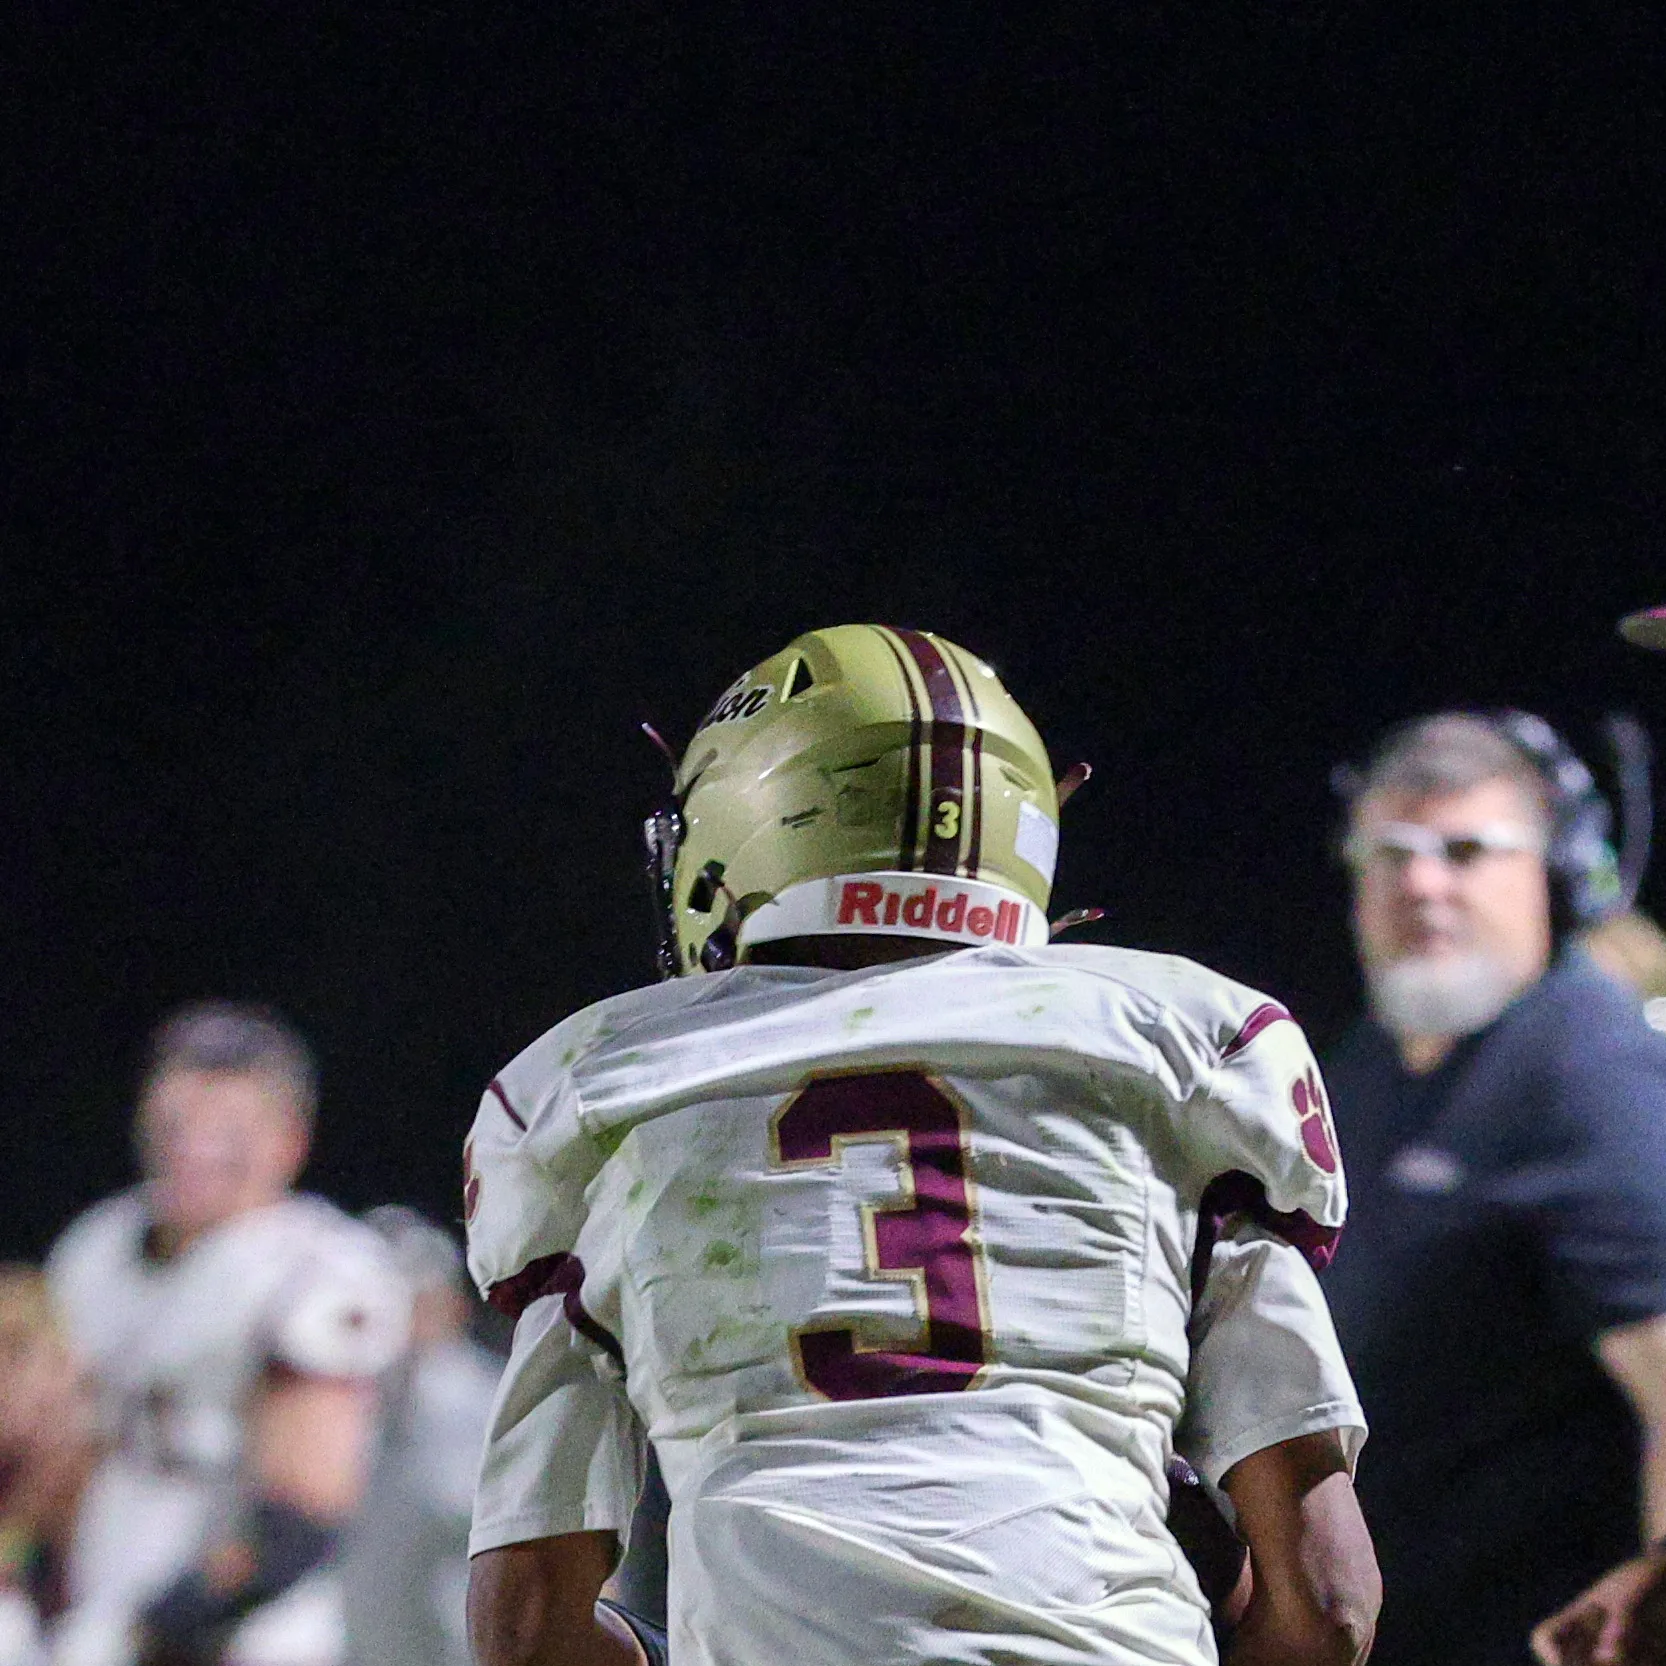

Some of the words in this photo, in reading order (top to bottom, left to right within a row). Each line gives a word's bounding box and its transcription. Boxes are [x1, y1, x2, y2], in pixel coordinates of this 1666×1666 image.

[934, 801, 961, 839] 3
[837, 882, 1022, 946] Riddell
[768, 1063, 992, 1402] 3
